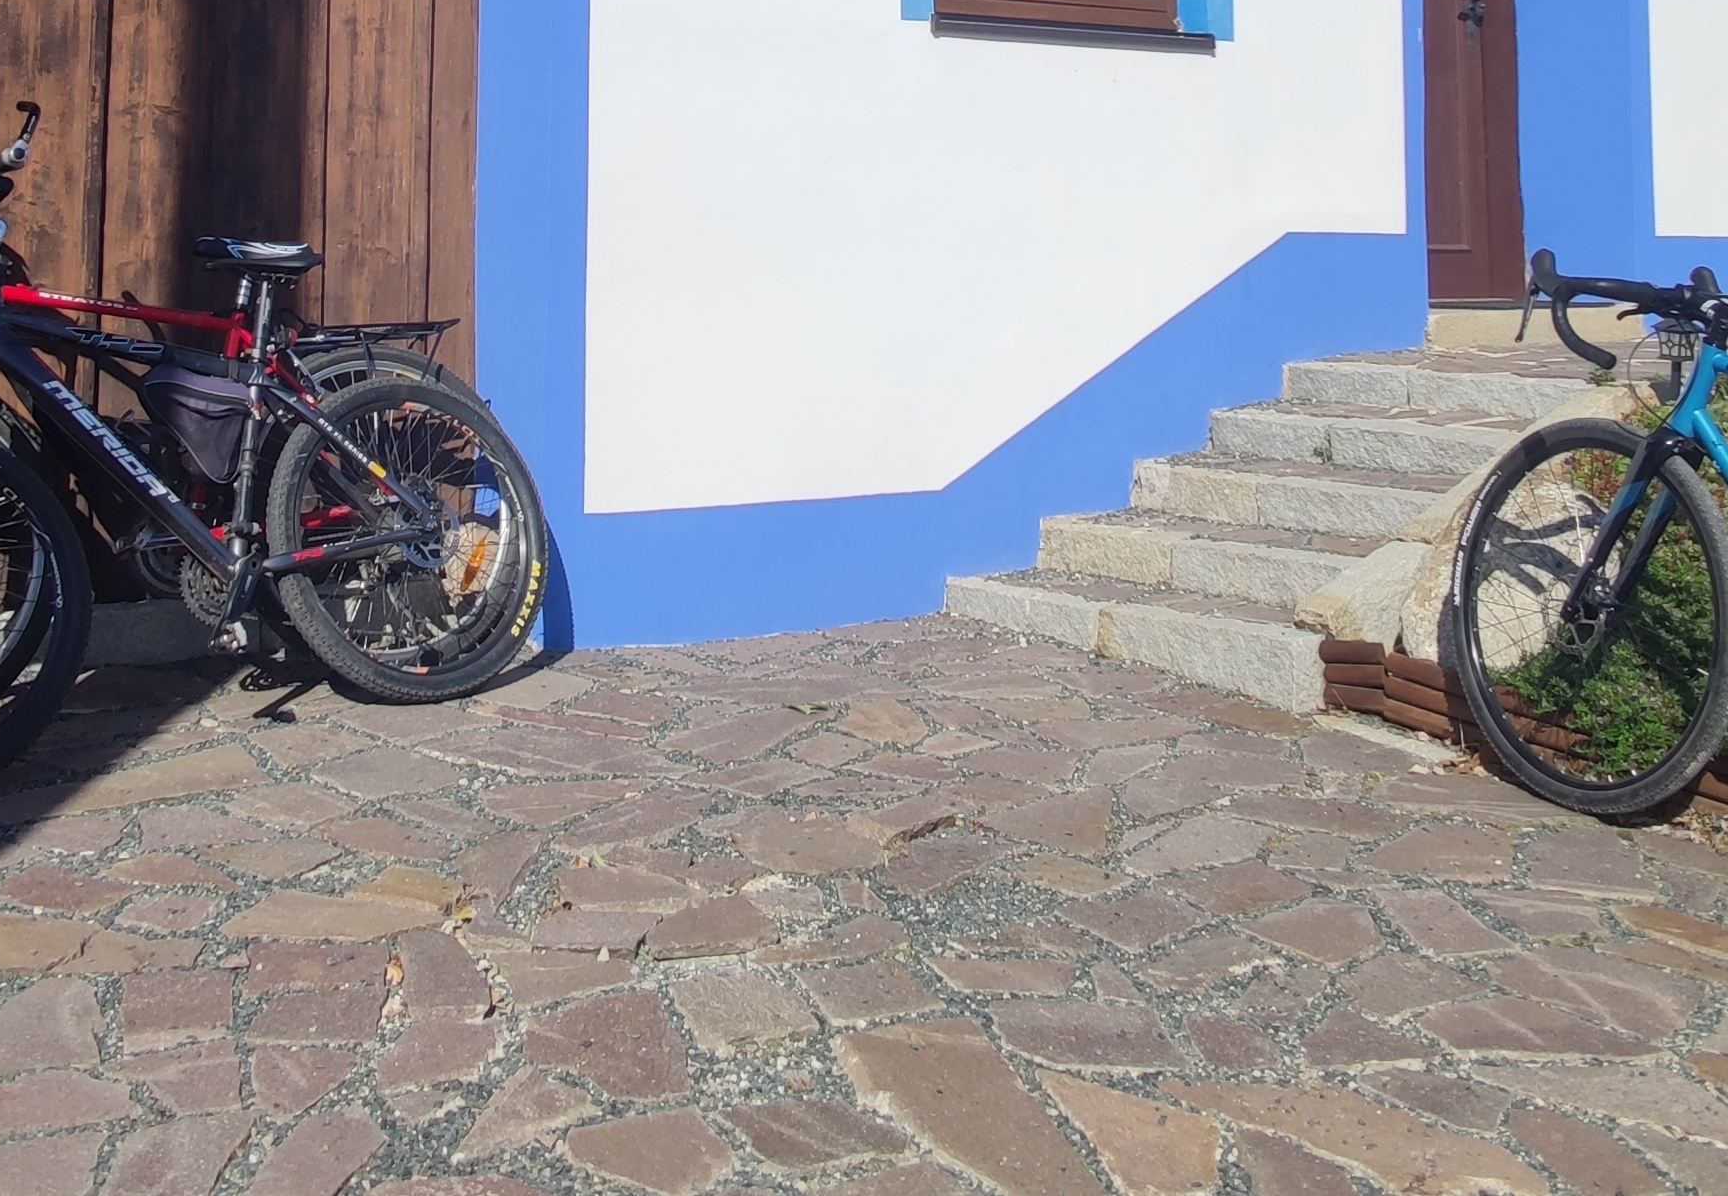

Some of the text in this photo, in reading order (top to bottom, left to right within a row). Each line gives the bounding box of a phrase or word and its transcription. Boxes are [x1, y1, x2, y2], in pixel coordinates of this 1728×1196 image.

[38, 292, 124, 309] STRATOS
[42, 380, 167, 497] MERIDA
[1461, 500, 1482, 546] POWER
[511, 560, 541, 637] MAXXIS
